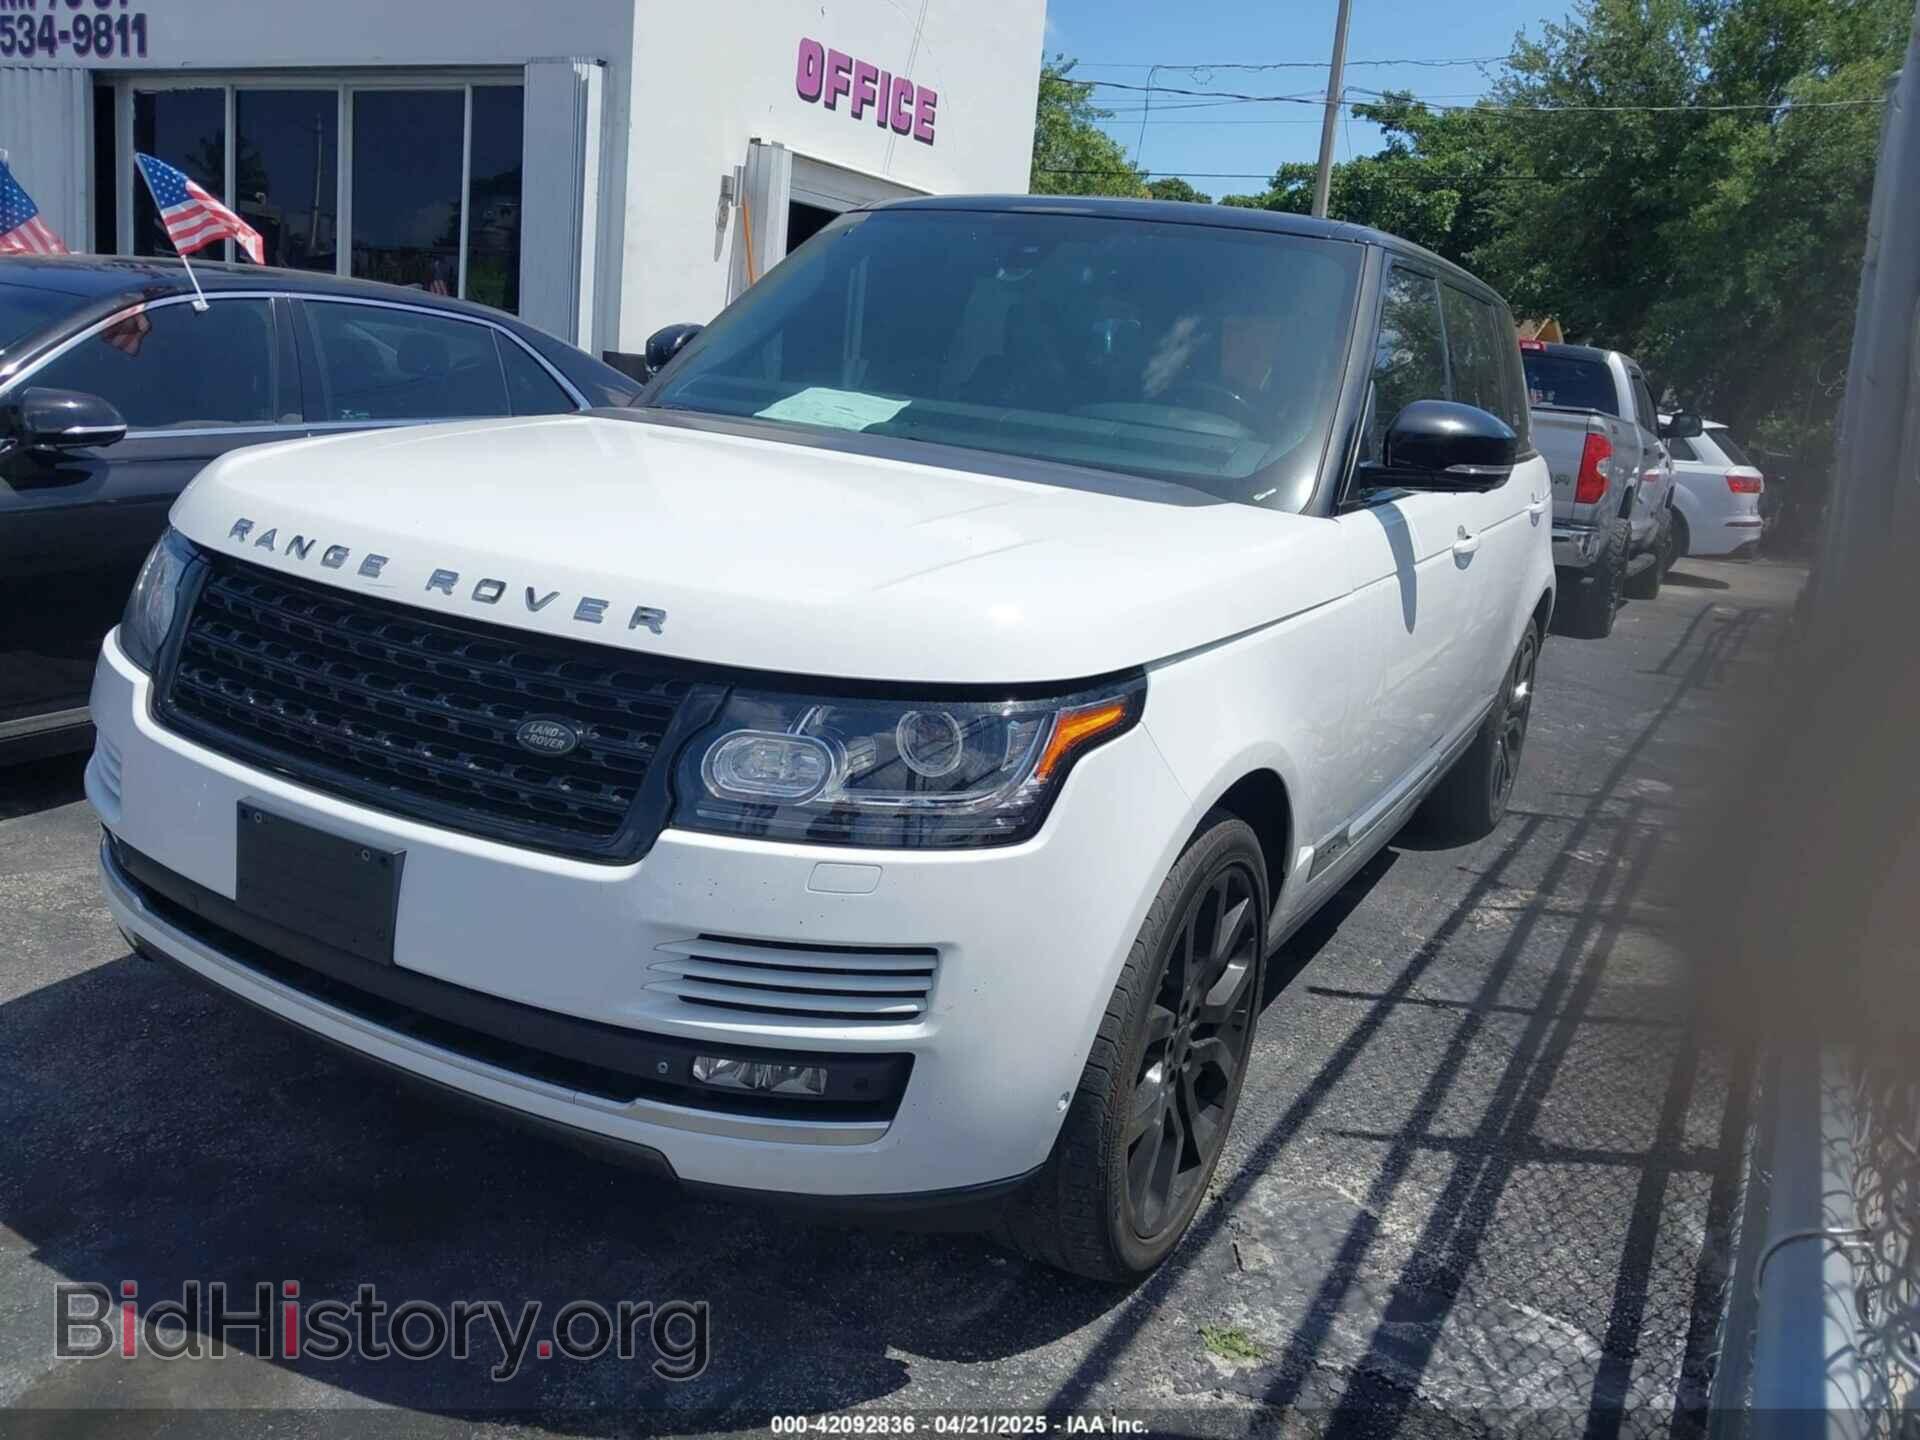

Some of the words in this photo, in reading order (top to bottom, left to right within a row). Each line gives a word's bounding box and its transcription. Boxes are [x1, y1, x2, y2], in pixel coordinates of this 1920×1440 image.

[0, 12, 148, 58] 534-9811
[796, 36, 938, 146] OFFICE
[228, 517, 389, 579] RANGE
[425, 568, 668, 634] ROVER
[528, 734, 565, 750] ROVER
